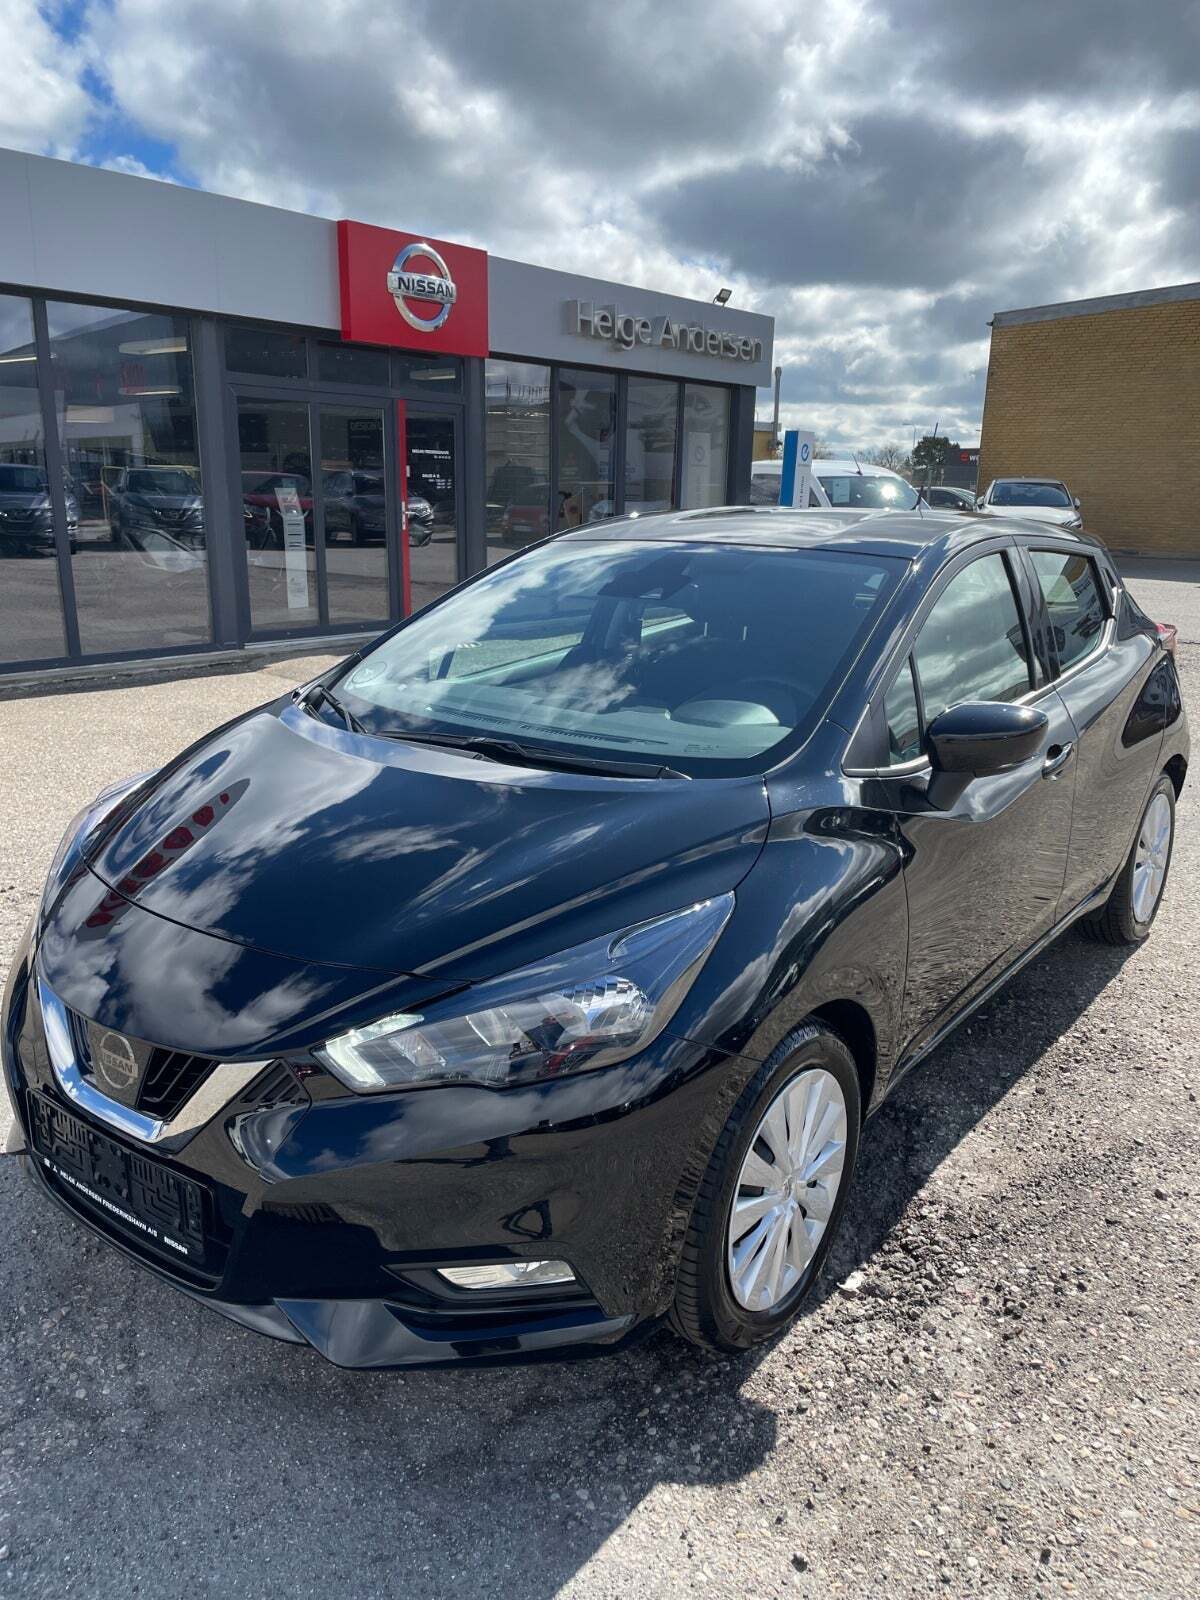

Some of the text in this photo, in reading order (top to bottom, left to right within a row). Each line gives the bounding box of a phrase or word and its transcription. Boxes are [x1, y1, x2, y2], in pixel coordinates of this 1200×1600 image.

[397, 277, 453, 297] NISSAN
[572, 299, 764, 361] Helge Andersen
[103, 1053, 133, 1072] NISSAN
[75, 1181, 103, 1203] ANDERSEN
[102, 1199, 147, 1231] FREDERIKSHAVN
[163, 1236, 189, 1255] NISSAN
